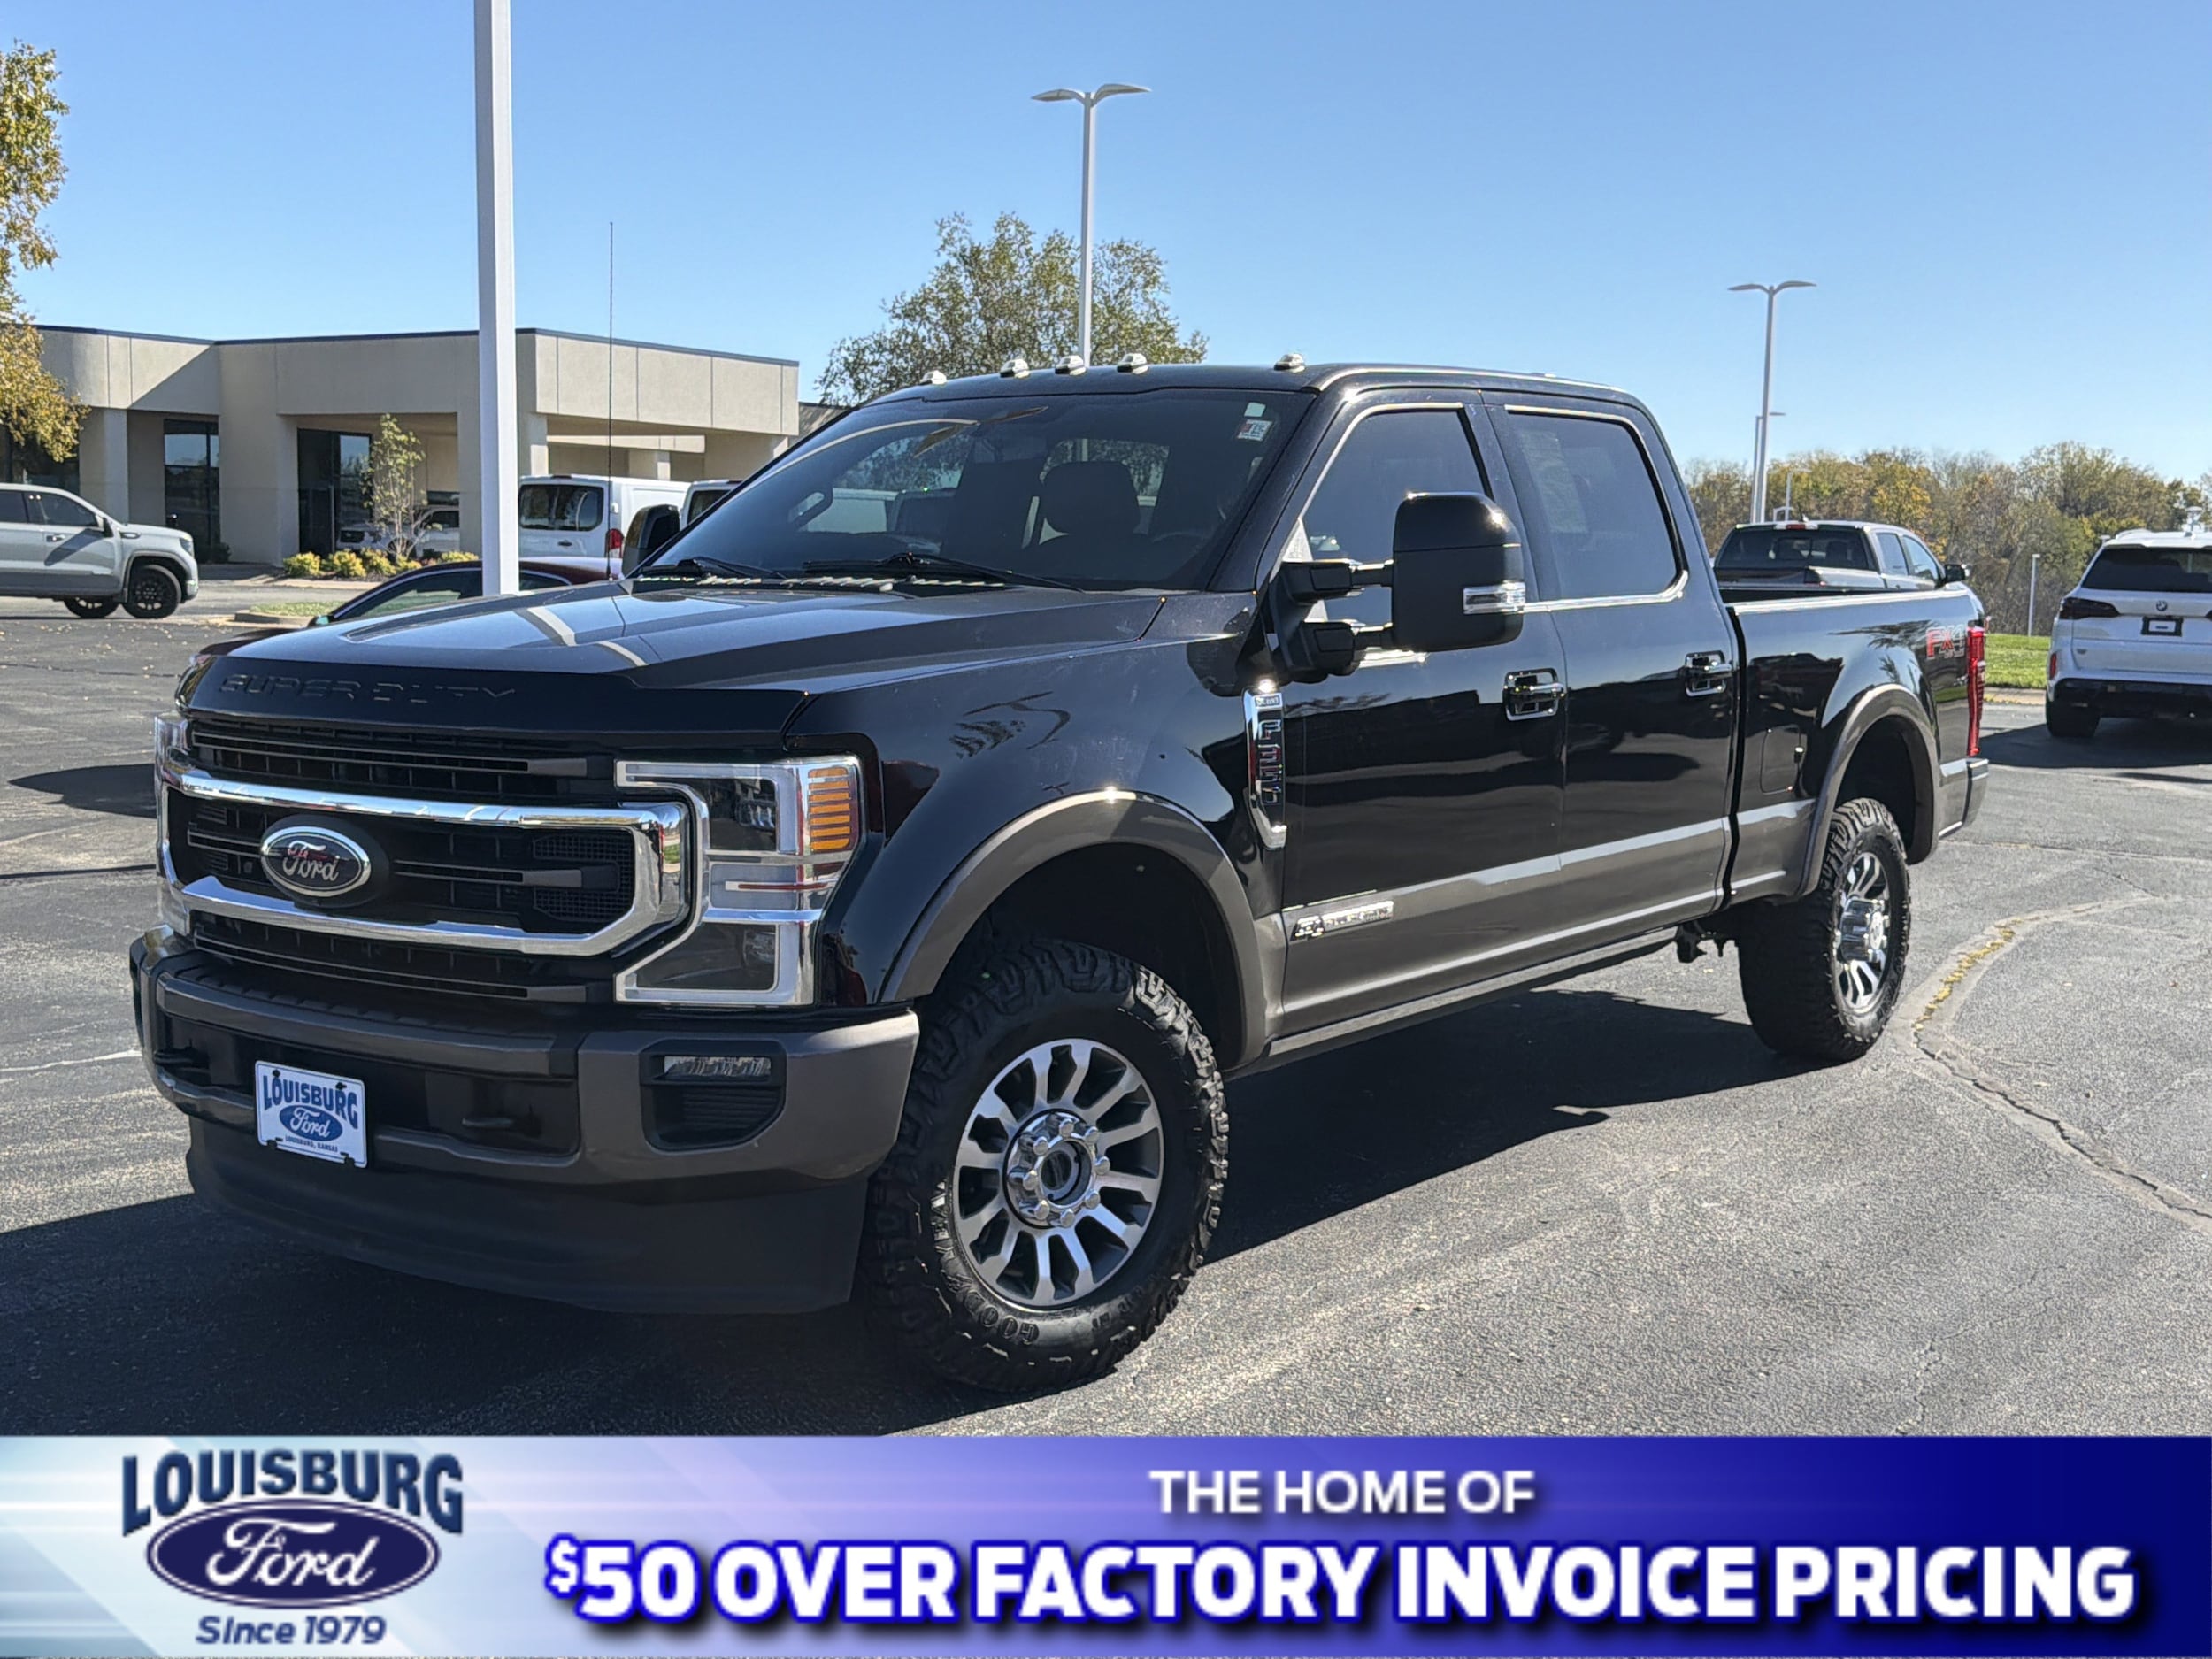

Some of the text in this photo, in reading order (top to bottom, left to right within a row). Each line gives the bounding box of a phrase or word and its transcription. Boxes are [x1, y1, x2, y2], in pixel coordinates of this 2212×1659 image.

[282, 839, 340, 882] Ford
[263, 1075, 358, 1130] LOUISBURG
[289, 1106, 331, 1138] Ford
